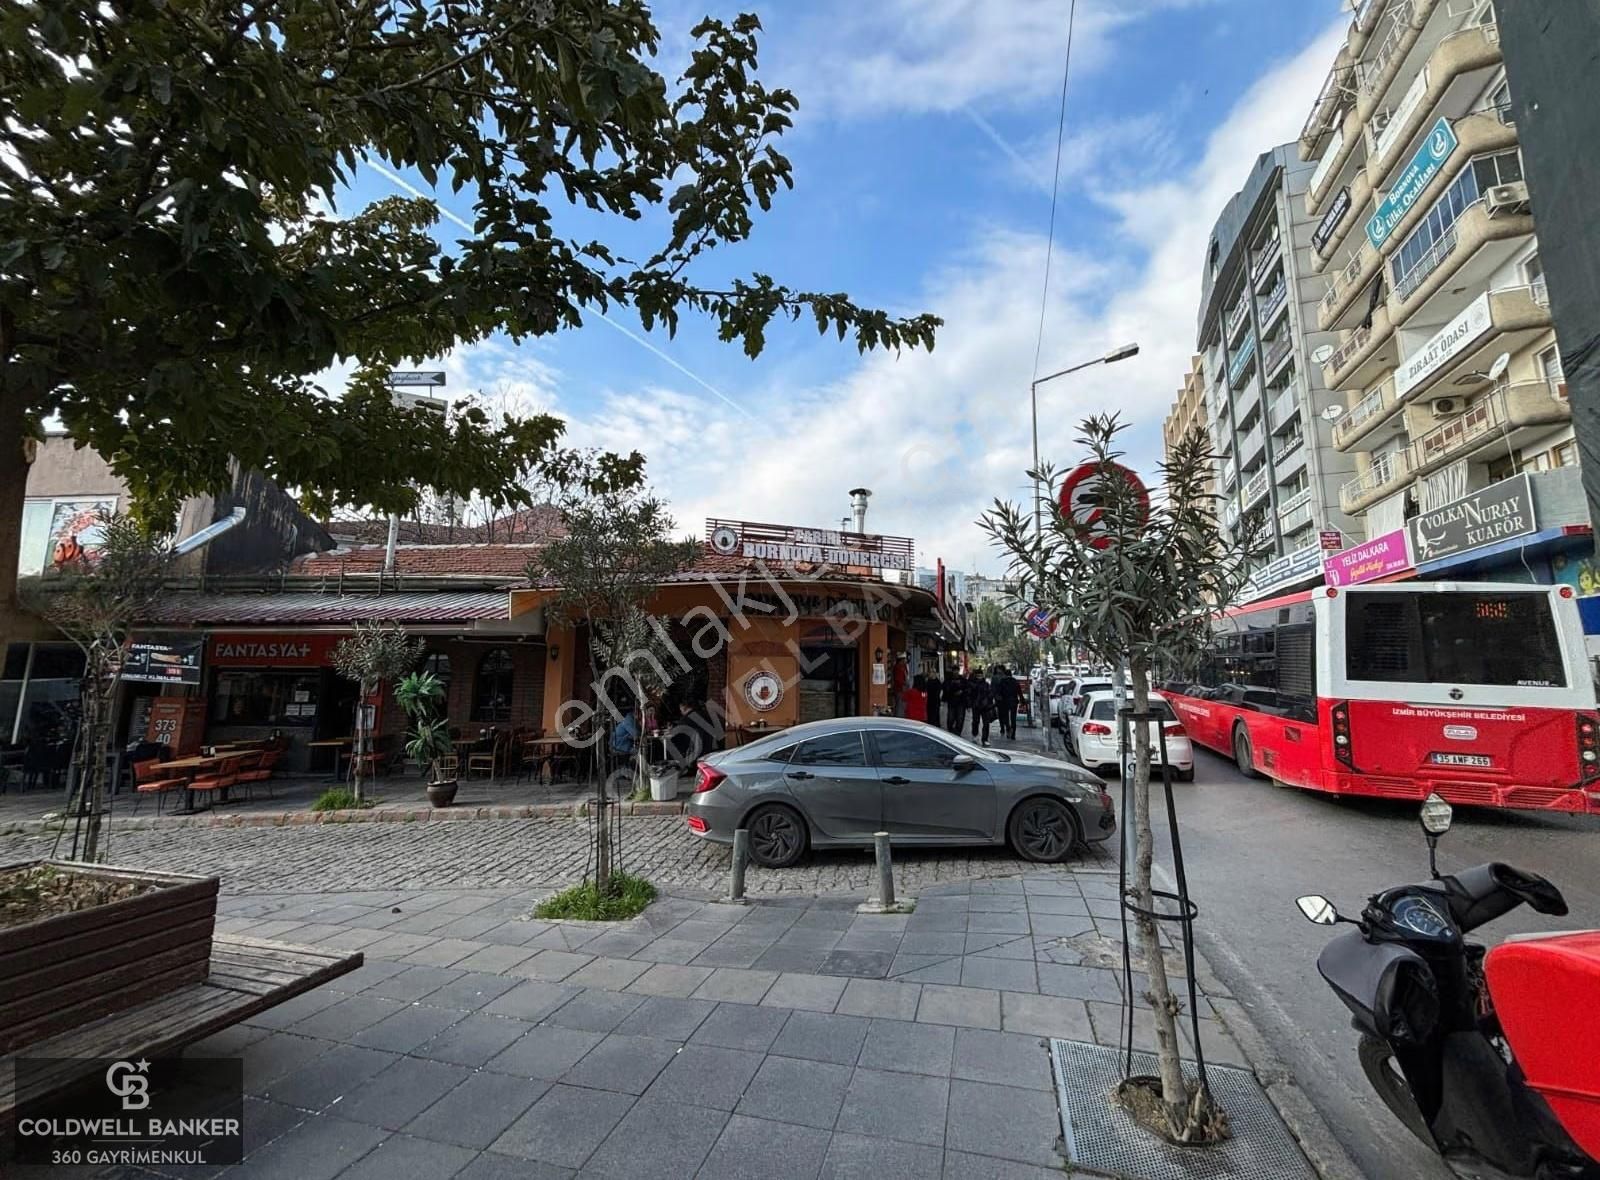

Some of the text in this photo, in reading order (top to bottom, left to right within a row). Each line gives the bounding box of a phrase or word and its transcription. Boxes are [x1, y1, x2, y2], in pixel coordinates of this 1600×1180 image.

[1440, 320, 1470, 353] ODASI
[1465, 515, 1526, 545] KUAFÖR
[742, 541, 824, 564] BORNOVA
[1358, 541, 1390, 562] DALKARA
[215, 643, 311, 658] FANTASYA+
[155, 719, 177, 731] 373
[1416, 709, 1473, 720] BÜYÜKŞEHİR
[1473, 712, 1526, 721] BELEDİYESİ
